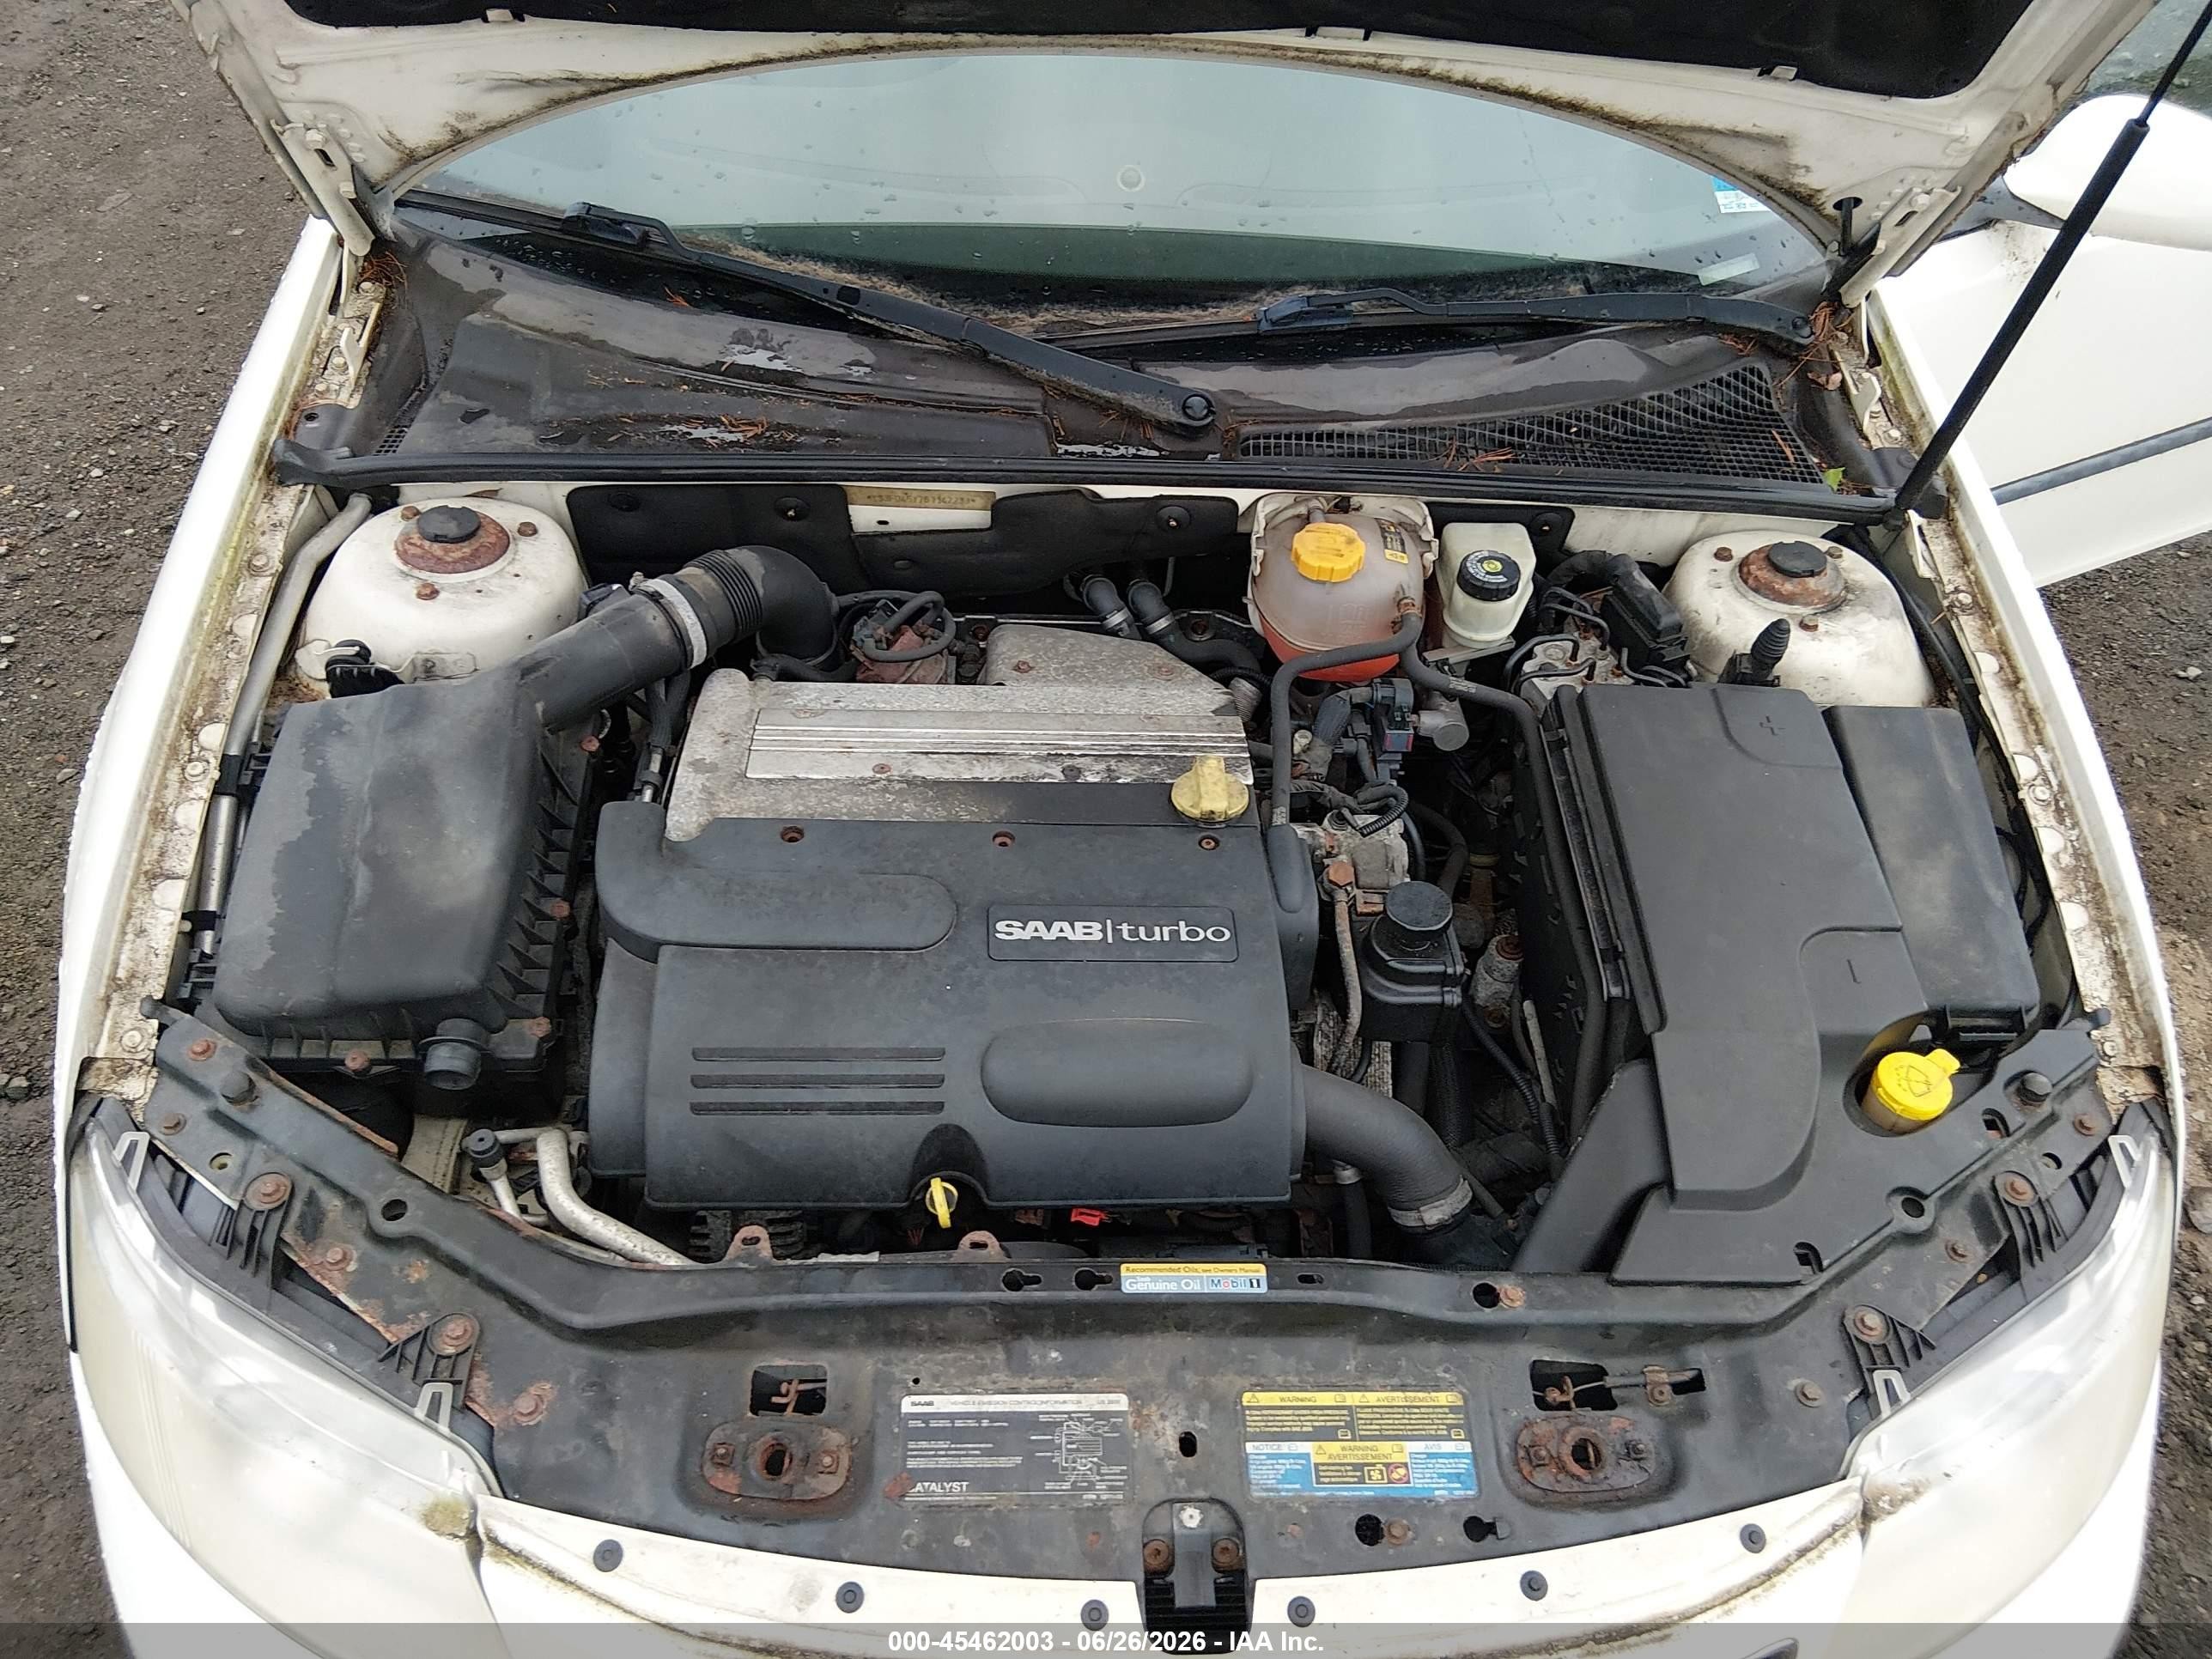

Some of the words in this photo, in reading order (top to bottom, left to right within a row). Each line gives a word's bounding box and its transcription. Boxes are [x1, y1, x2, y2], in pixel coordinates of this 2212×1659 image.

[994, 919, 1103, 941] SAAB
[1115, 920, 1231, 943] turbo
[1125, 1266, 1182, 1274] Recommended
[1126, 1279, 1178, 1291] Genuine
[1181, 1279, 1201, 1291] Oil
[1211, 1278, 1247, 1290] Mobil
